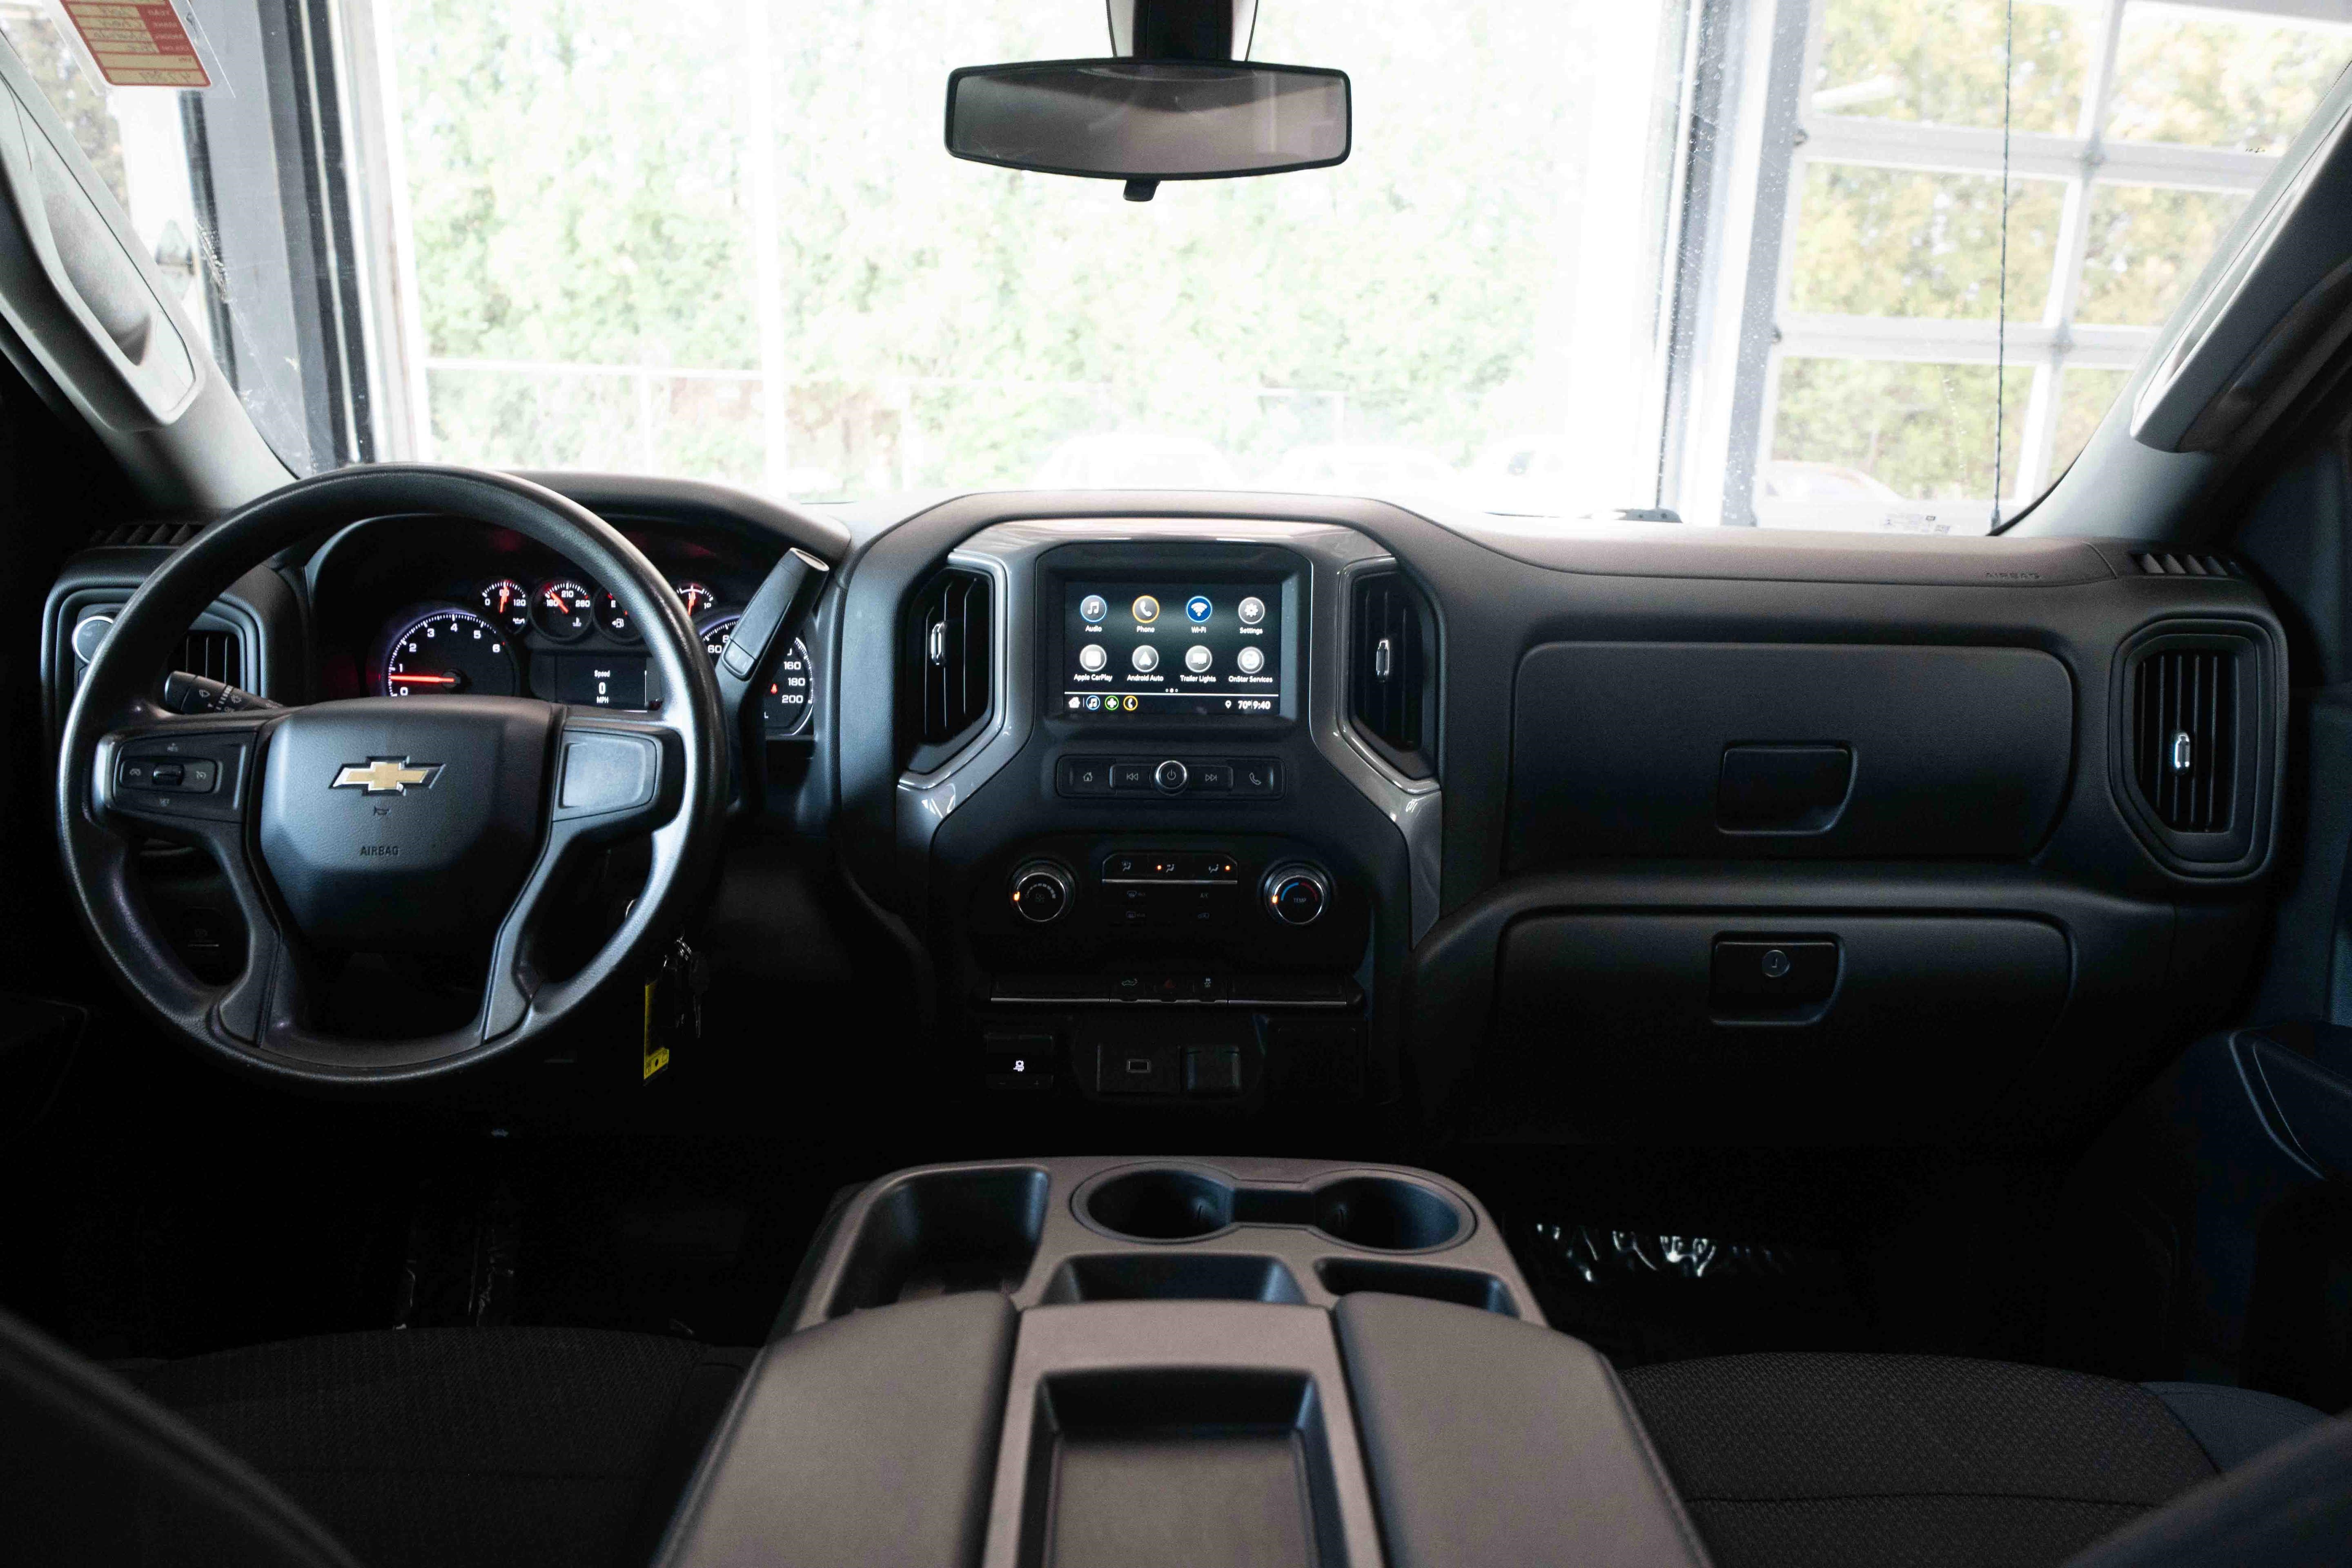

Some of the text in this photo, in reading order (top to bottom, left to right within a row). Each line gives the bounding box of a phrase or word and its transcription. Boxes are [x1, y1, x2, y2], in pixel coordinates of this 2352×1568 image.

[450, 623, 458, 632] 4
[1240, 627, 1263, 635] Settings
[427, 628, 435, 638] 3
[474, 630, 481, 639] 5
[409, 643, 417, 652] 2
[492, 644, 500, 653] 6
[708, 645, 722, 653] 60
[399, 664, 403, 673] 1
[784, 662, 802, 670] 160
[788, 678, 806, 686] 180
[1091, 674, 1113, 682] CarPlay
[1198, 675, 1216, 684] Lights
[400, 687, 408, 696] 0
[599, 682, 606, 694] 0
[782, 695, 804, 704] 200
[1253, 701, 1271, 710] 9:40
[360, 846, 399, 856] AIRBAG
